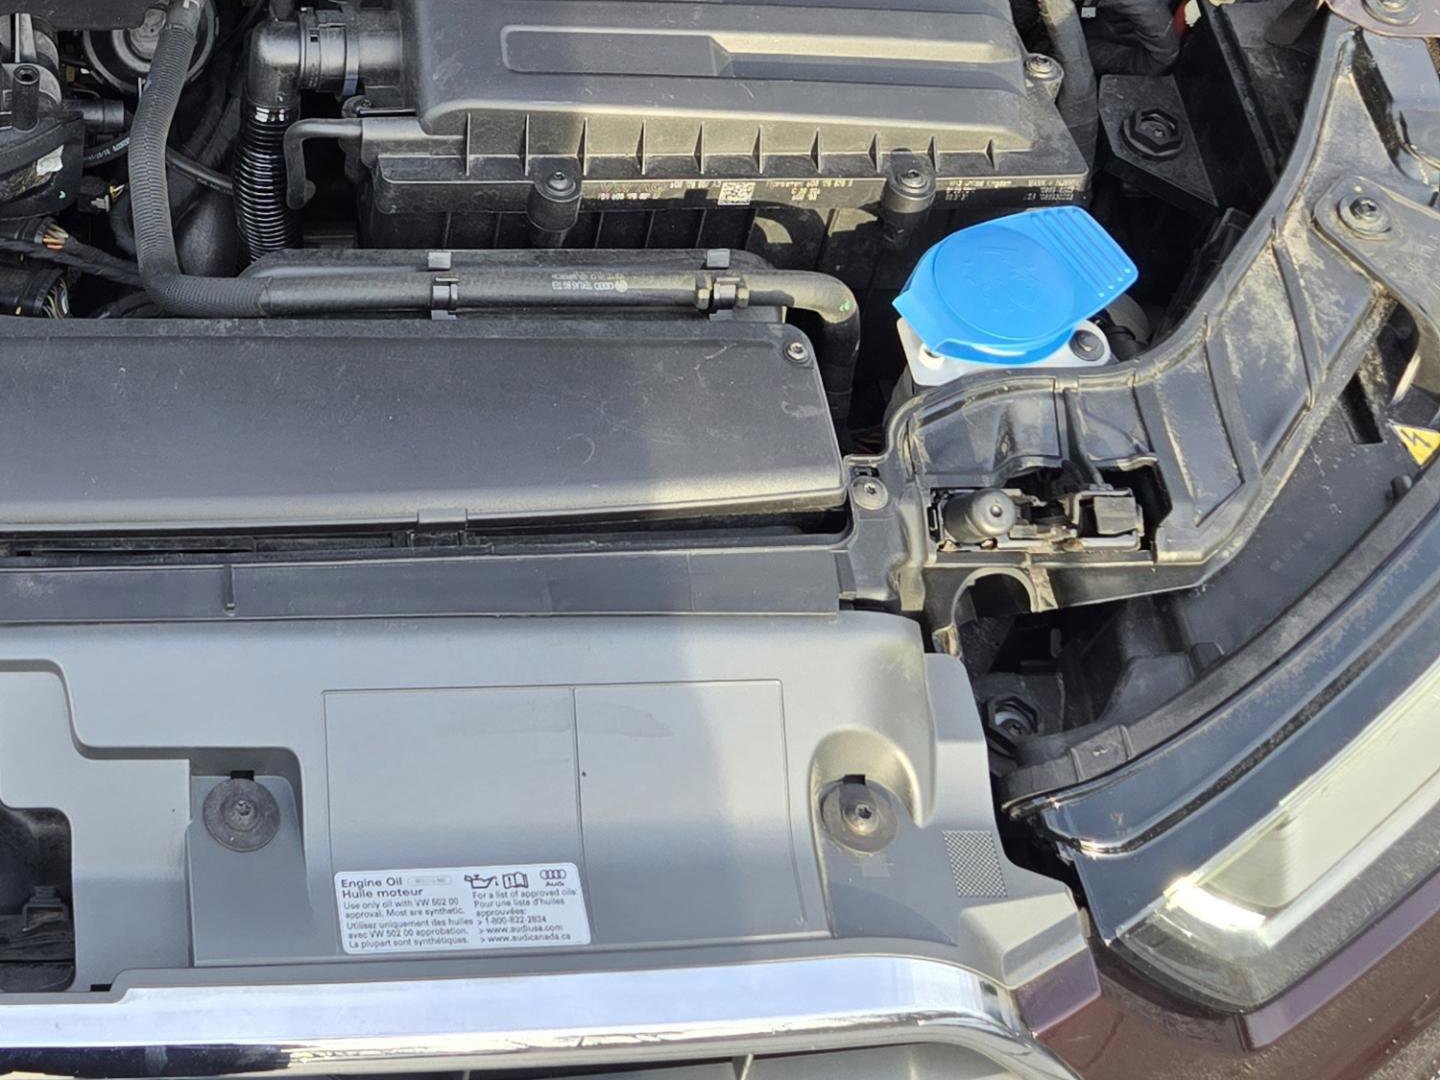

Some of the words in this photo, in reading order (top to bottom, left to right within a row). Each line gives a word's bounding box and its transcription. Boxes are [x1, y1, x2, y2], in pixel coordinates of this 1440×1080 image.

[341, 878, 382, 889] Engine
[386, 877, 402, 887] Oil
[342, 889, 373, 899] Huile
[377, 888, 423, 898] moteur
[472, 891, 486, 899] For
[495, 890, 508, 899] list
[510, 890, 519, 898] of
[521, 888, 560, 899] approved
[344, 901, 359, 910] Use
[362, 900, 380, 911] only
[382, 899, 392, 908] oil
[395, 898, 413, 907] with
[415, 898, 429, 907] VW
[431, 897, 446, 906] 502
[448, 897, 459, 906] 00
[473, 900, 494, 908] Pour
[513, 898, 531, 906] liste
[386, 908, 408, 917] Most
[346, 920, 376, 930] Utilisez
[380, 919, 429, 930] uniquement
[431, 918, 446, 927] des
[448, 916, 474, 926] huiles
[369, 929, 384, 938] VW
[386, 929, 402, 938] 502
[404, 928, 414, 937] 00
[349, 940, 359, 949] La
[361, 938, 391, 949] plupart
[393, 937, 411, 946] sont
